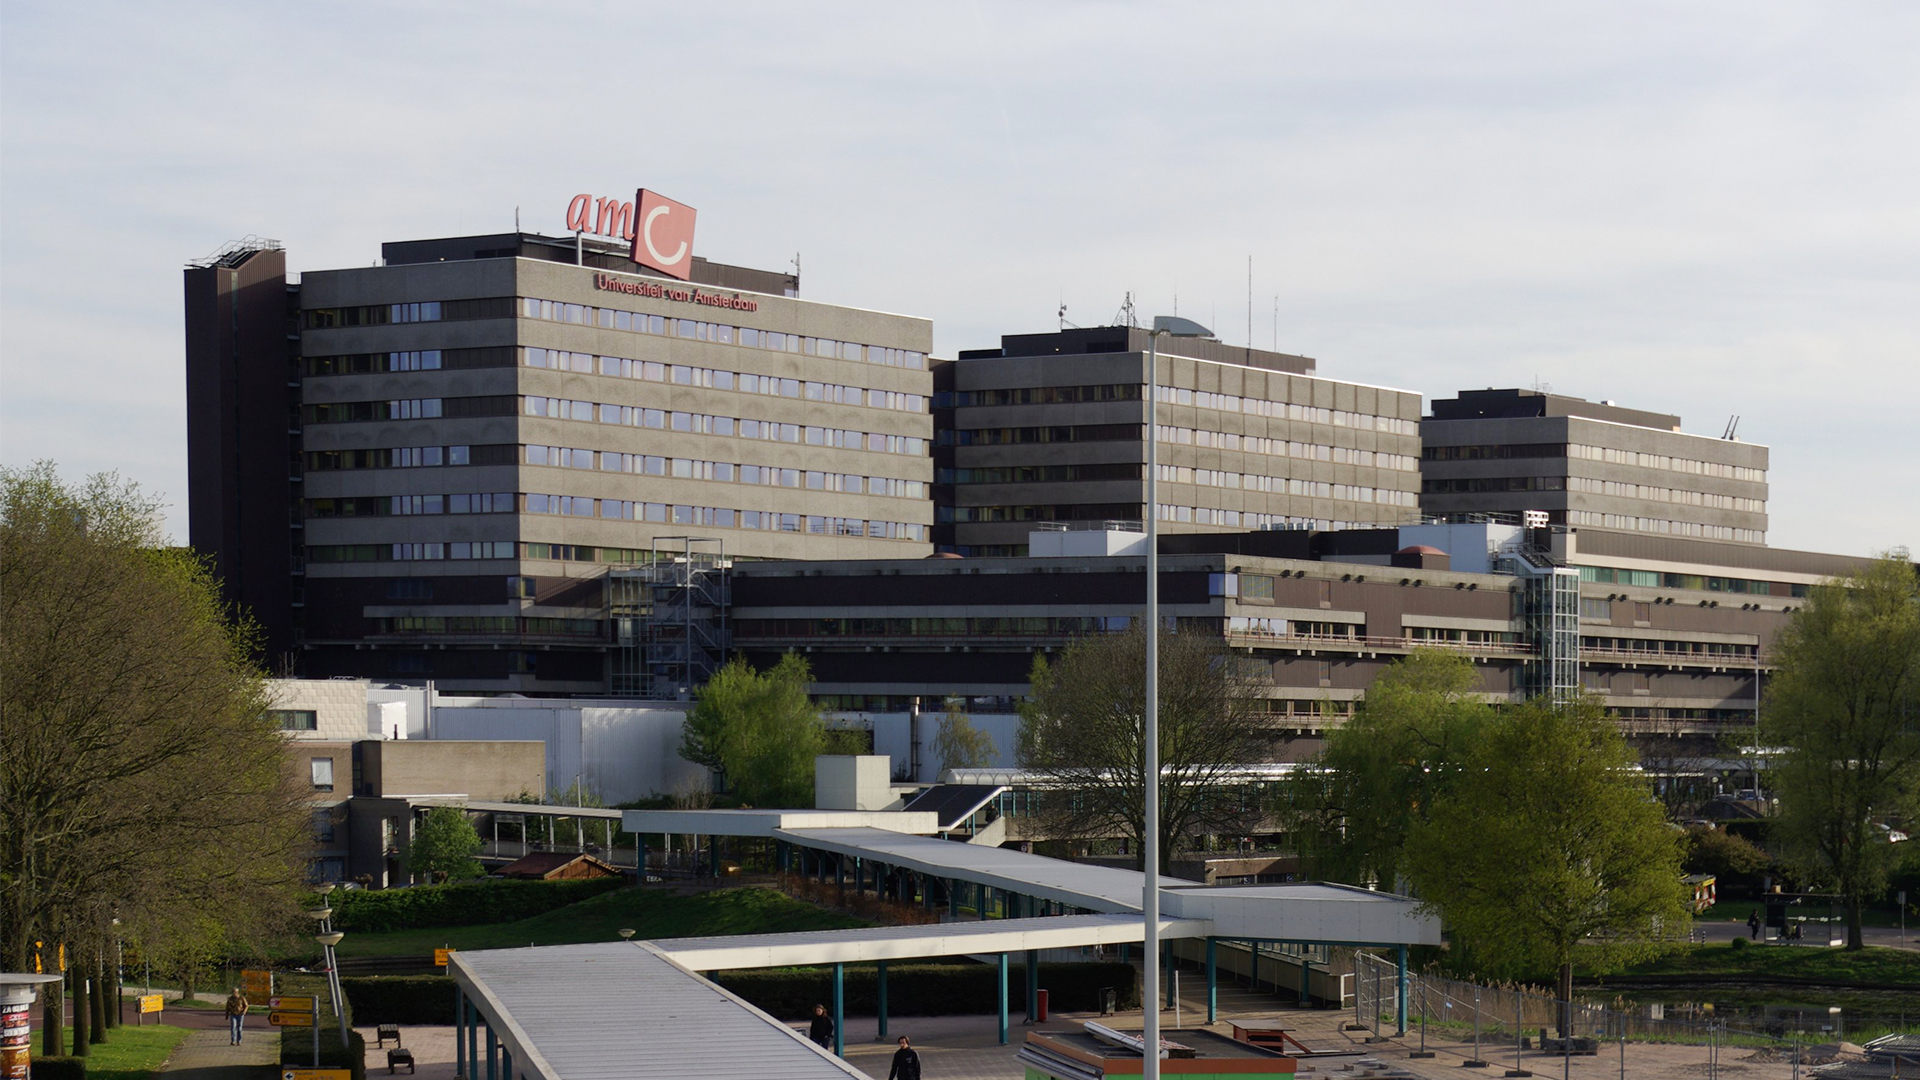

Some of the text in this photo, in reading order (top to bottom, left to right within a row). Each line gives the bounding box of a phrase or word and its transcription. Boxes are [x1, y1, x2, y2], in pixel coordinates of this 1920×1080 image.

[597, 272, 758, 312] Universiteit van Amsterdam
